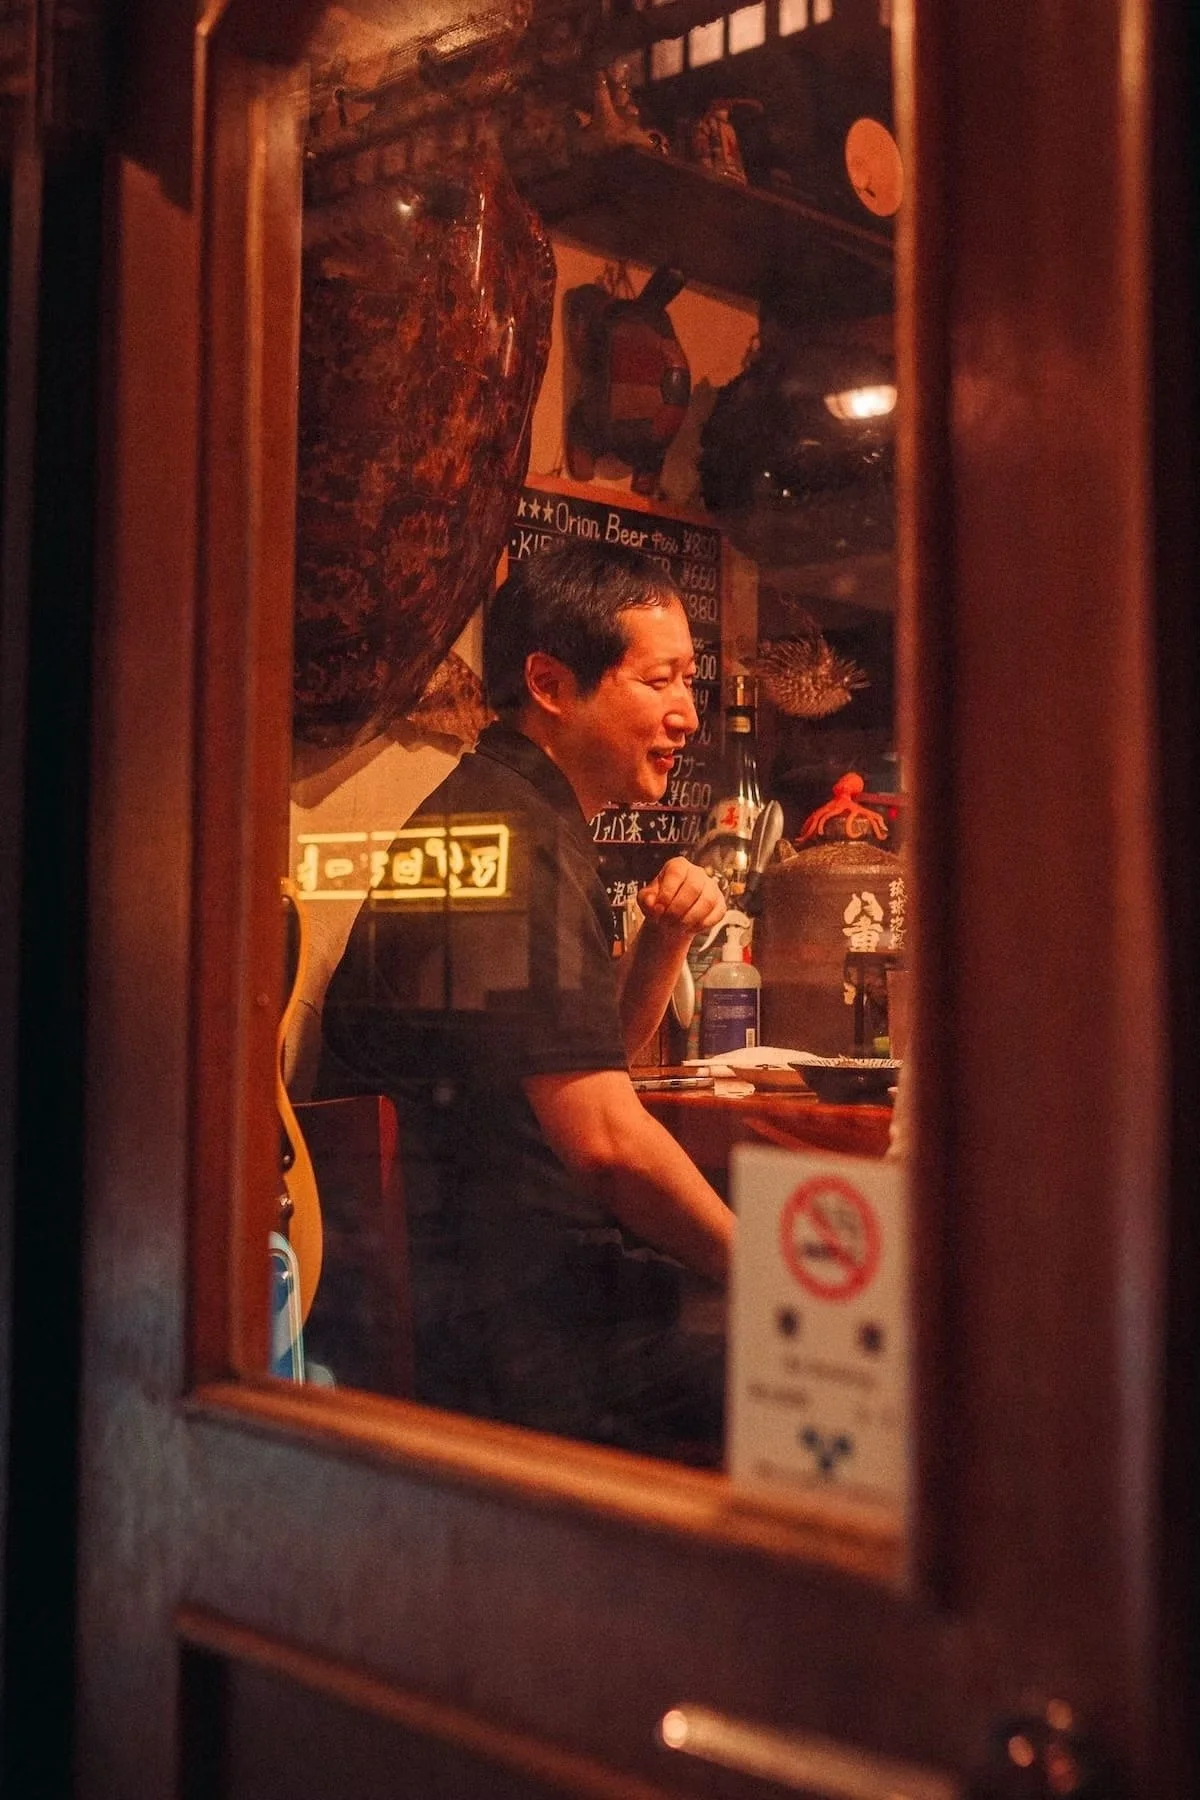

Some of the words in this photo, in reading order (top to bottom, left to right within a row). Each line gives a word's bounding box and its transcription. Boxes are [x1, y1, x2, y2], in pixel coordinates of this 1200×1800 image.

[555, 502, 600, 540] Orion
[604, 513, 649, 548] Beer
[668, 780, 712, 808] ¥600
